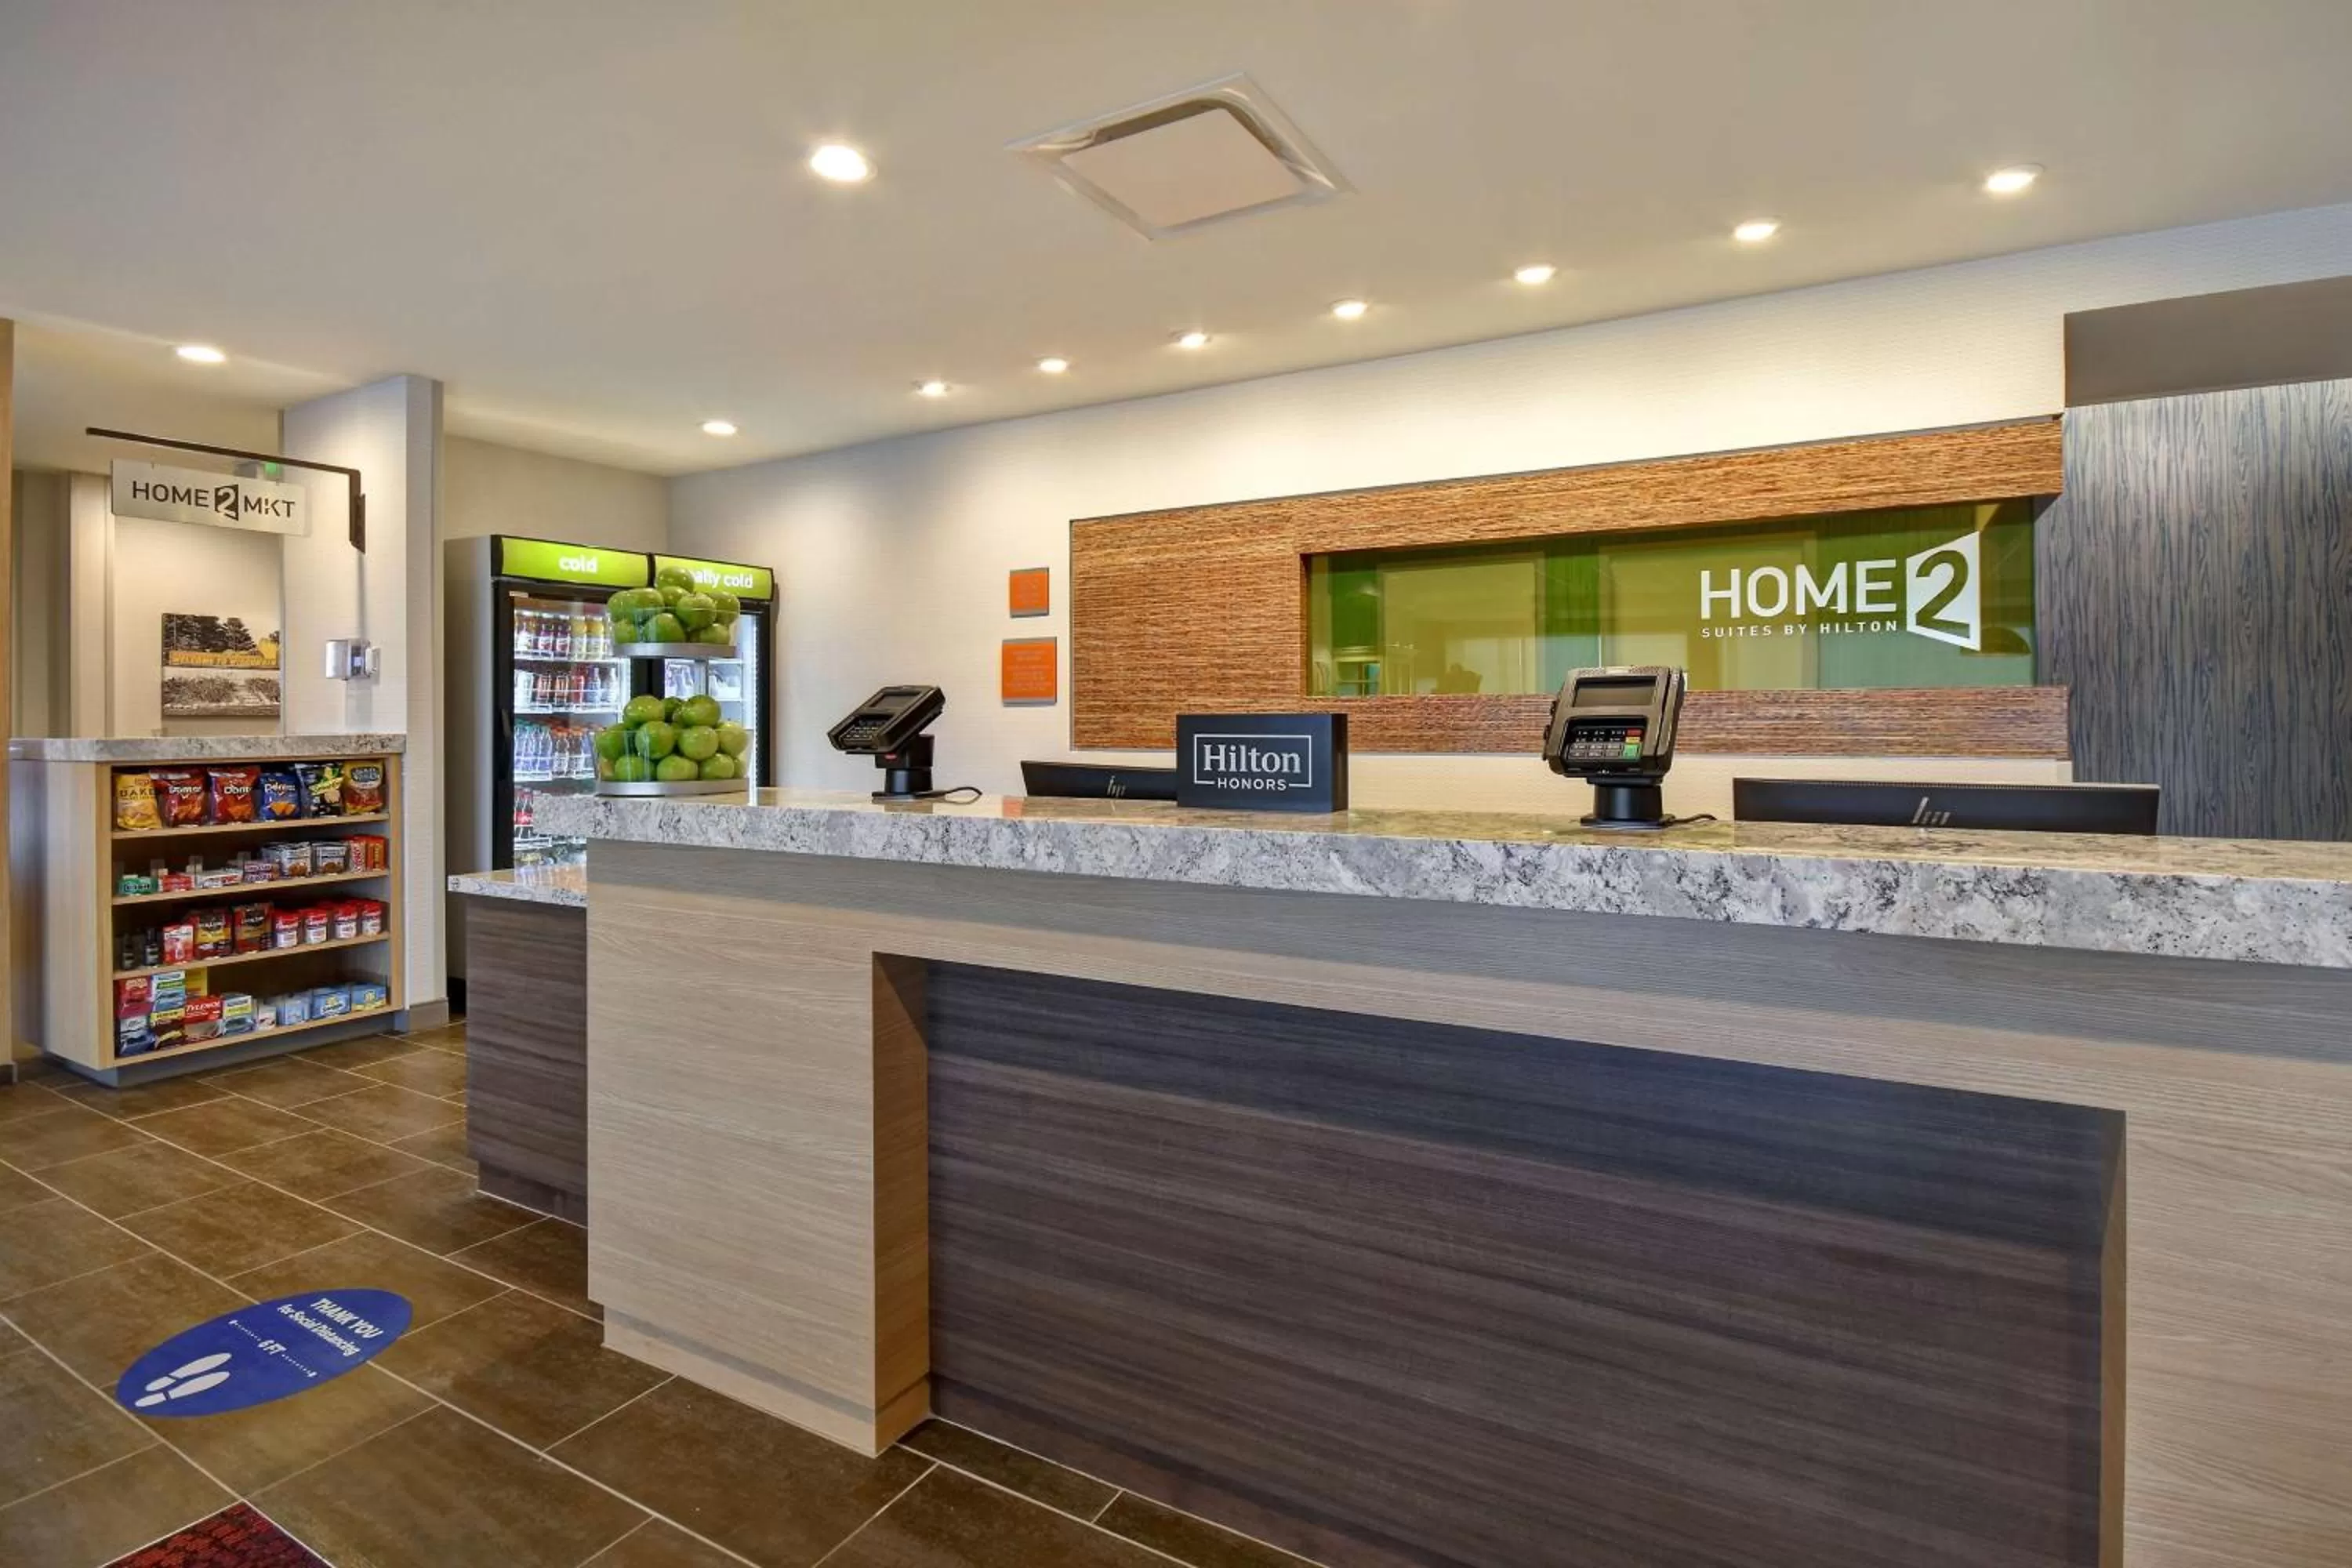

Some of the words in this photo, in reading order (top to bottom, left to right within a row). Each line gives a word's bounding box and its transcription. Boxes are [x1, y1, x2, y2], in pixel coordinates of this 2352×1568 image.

[244, 495, 296, 518] MKT
[558, 554, 598, 573] cold
[724, 572, 753, 589] cold
[1701, 625, 1773, 638] SUITES
[1784, 623, 1807, 635] BY
[1819, 620, 1898, 633] HILTON
[1203, 744, 1301, 774] Hilton
[1218, 777, 1287, 790] HONORS
[186, 1000, 221, 1013] TYLENOL
[310, 1298, 361, 1326] THANK
[347, 1319, 384, 1339] YOU
[263, 1343, 287, 1356] FT
[310, 1324, 361, 1357] Distancing
